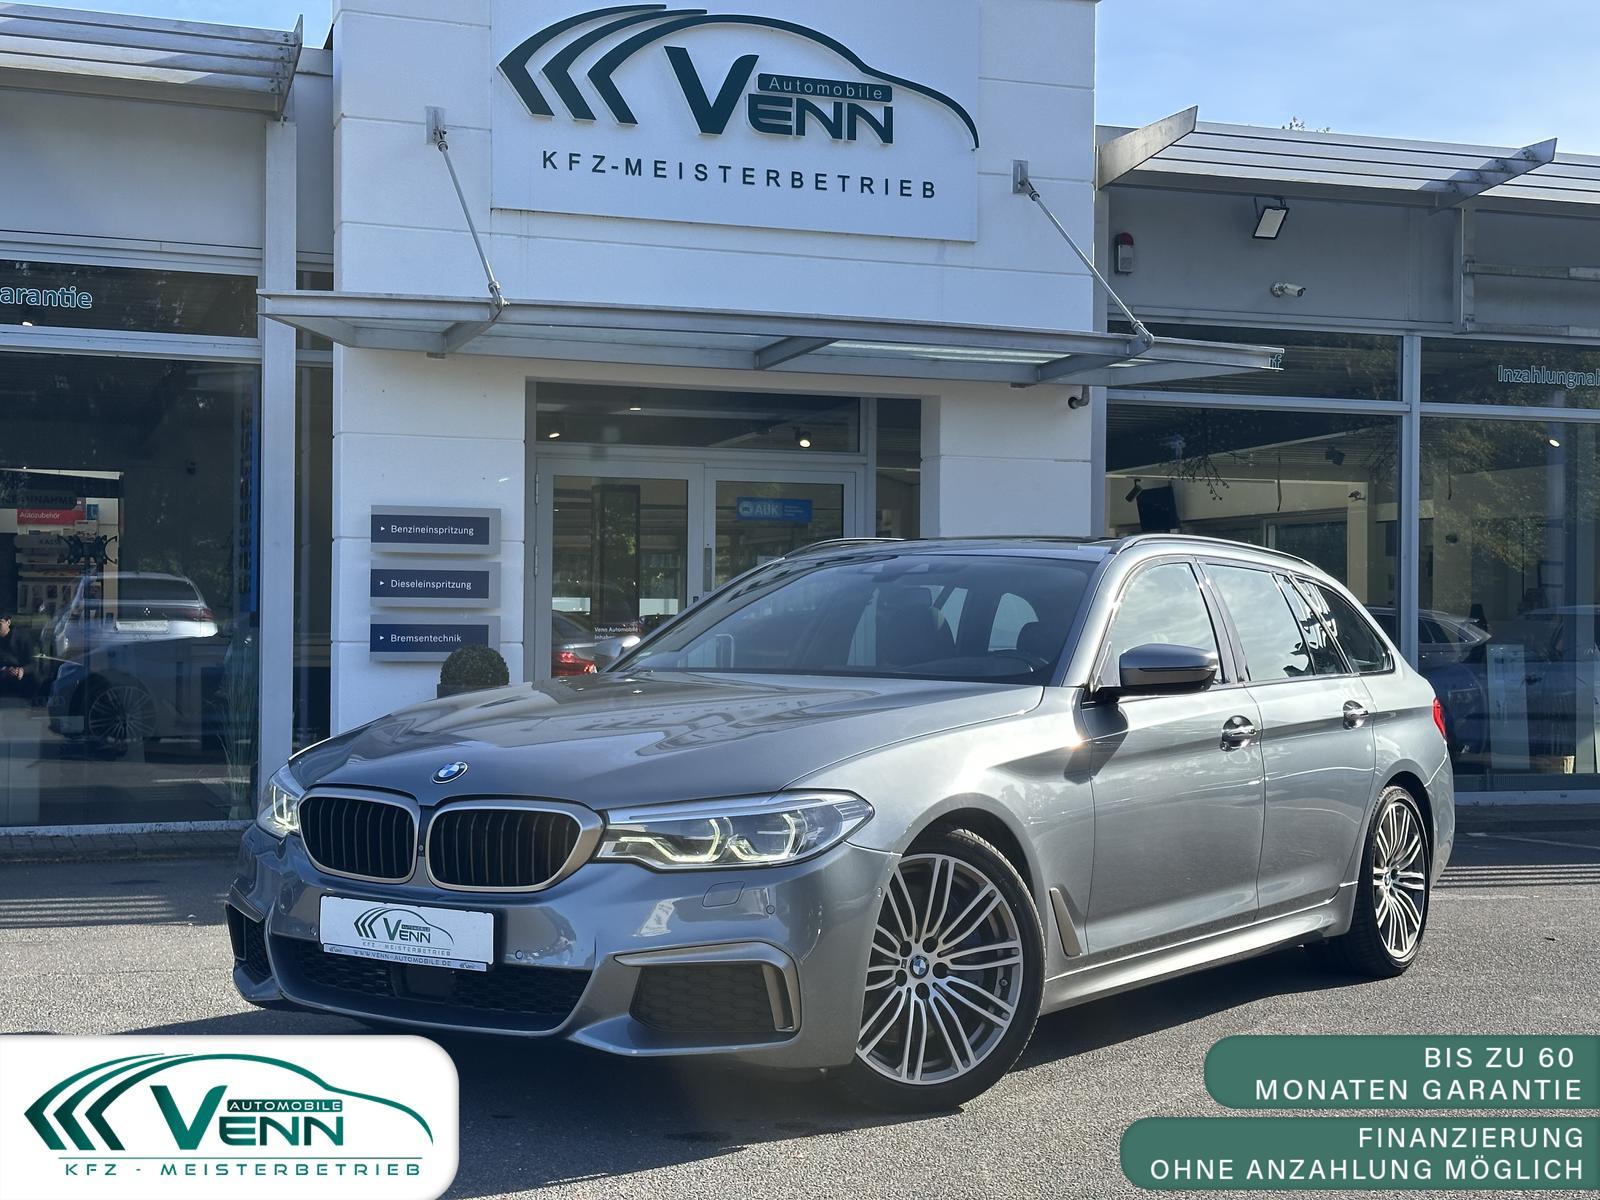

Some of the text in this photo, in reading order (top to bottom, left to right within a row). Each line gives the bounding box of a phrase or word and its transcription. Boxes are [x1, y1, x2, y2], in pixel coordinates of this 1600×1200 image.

[769, 76, 883, 99] Automobile
[390, 525, 475, 537] Benzineinspritzung
[390, 580, 472, 591] Dieseleinspritzung
[390, 633, 462, 643] Bremsentechnik
